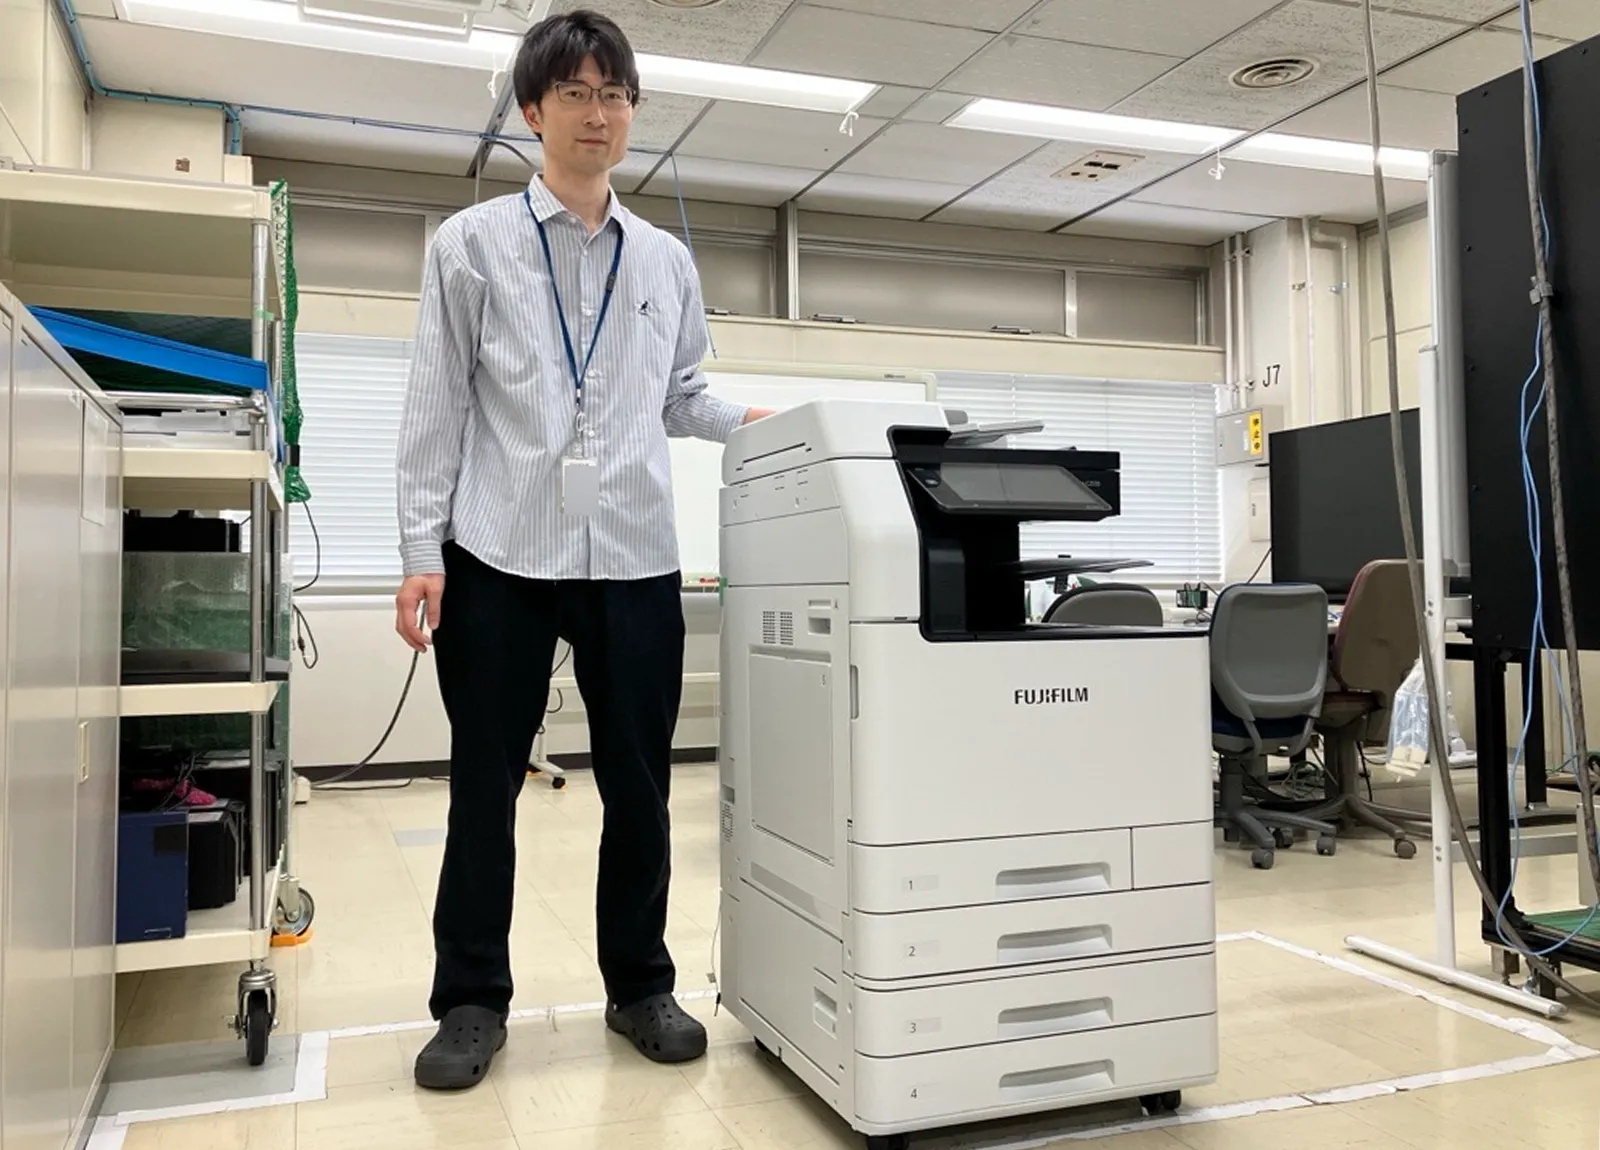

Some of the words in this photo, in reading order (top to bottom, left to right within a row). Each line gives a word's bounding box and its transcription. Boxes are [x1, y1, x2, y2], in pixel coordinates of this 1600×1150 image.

[1262, 364, 1281, 388] J7
[1014, 687, 1089, 705] FUJIFILM
[908, 880, 913, 890] 1
[908, 945, 916, 957] 2
[909, 1022, 917, 1034] 3
[910, 1088, 918, 1099] 4
